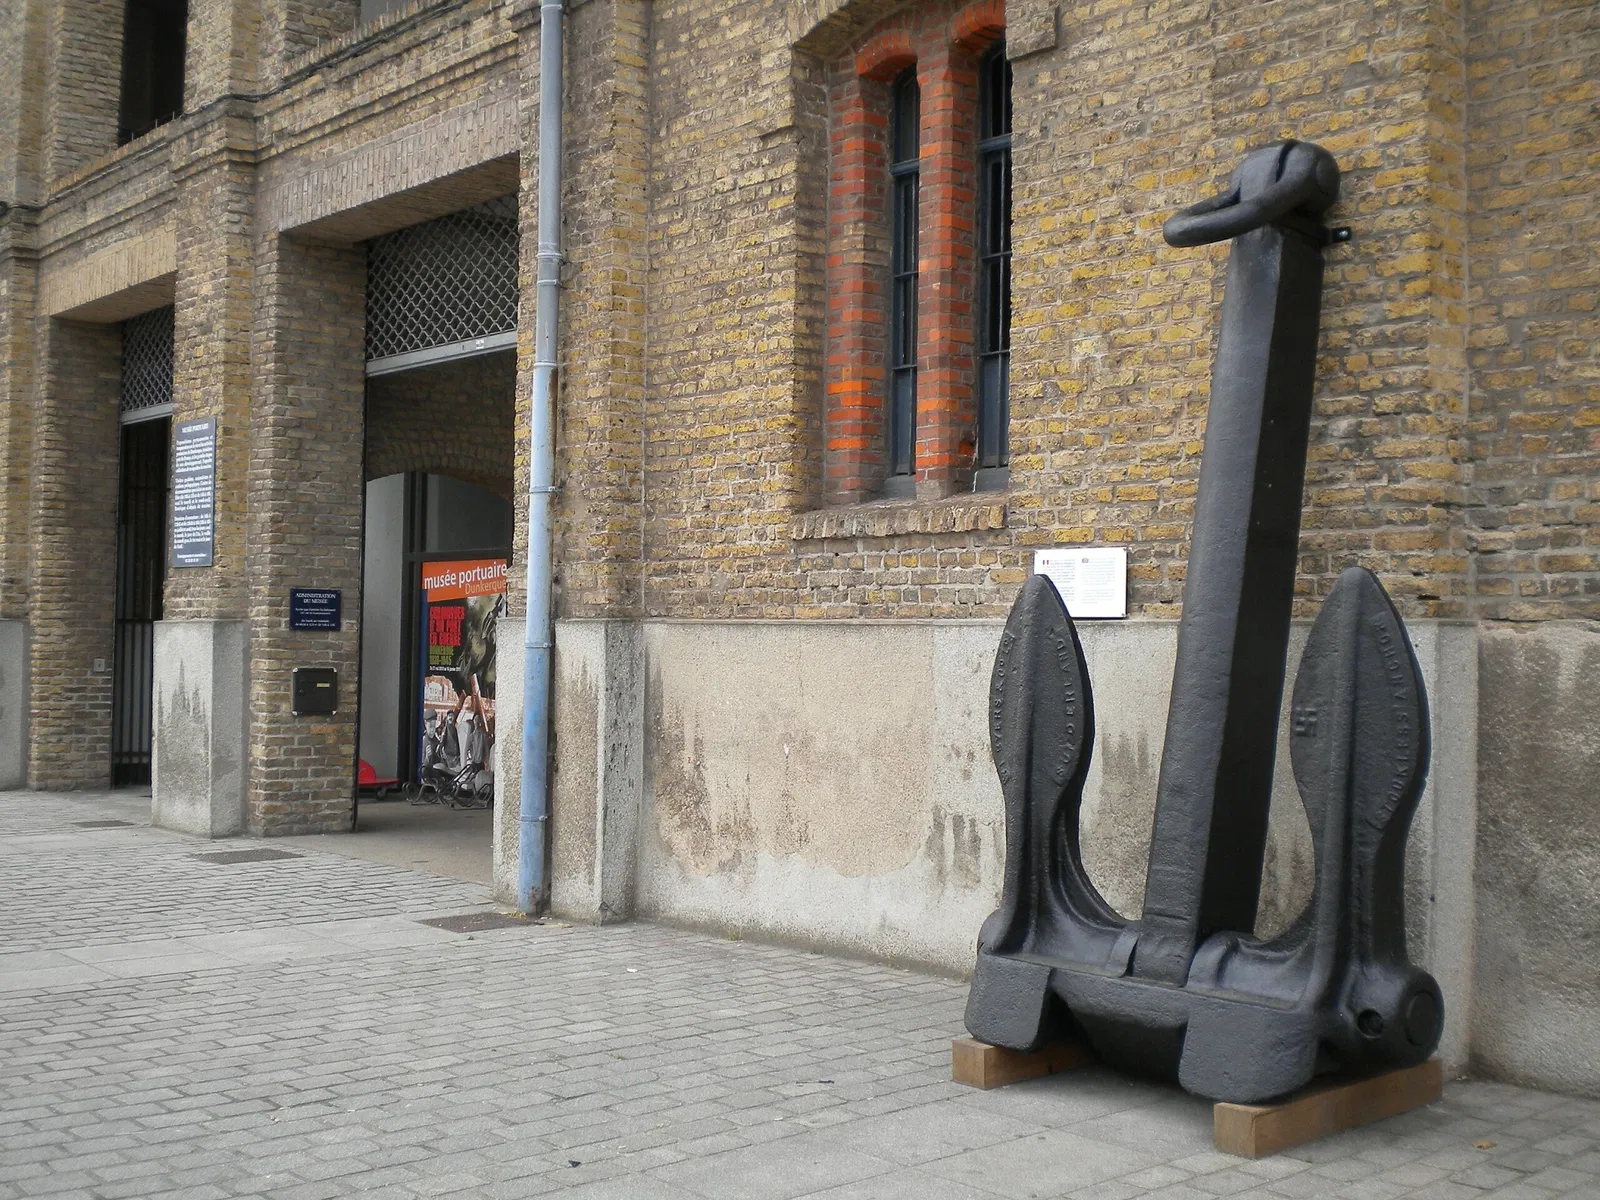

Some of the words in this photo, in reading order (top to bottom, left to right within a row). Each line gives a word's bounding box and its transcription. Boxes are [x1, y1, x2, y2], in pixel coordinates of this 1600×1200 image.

[424, 569, 457, 590] musée
[458, 561, 507, 589] portuaire
[465, 579, 507, 595] Dunkerque
